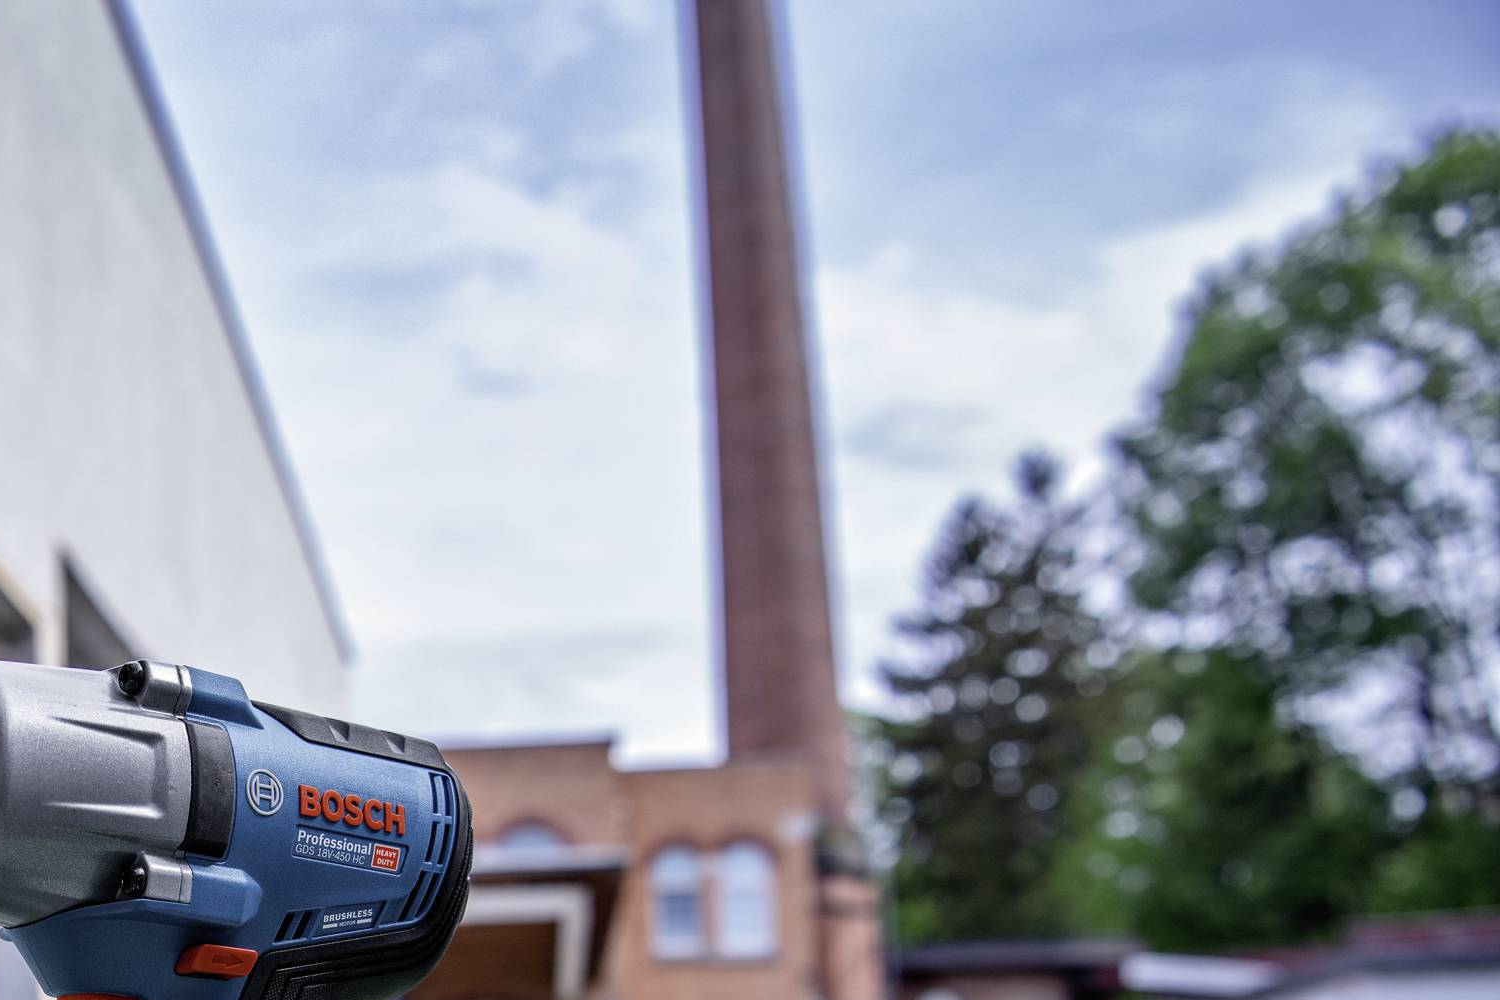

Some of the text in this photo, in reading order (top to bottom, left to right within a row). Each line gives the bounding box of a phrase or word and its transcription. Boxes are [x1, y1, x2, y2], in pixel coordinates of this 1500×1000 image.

[299, 784, 405, 836] BOSCH
[297, 829, 372, 855] Professional
[295, 843, 315, 855] GDS
[352, 854, 366, 865] HC
[376, 848, 398, 858] HEAVY
[376, 858, 395, 867] DUTY
[323, 908, 373, 923] BRUSHLESS
